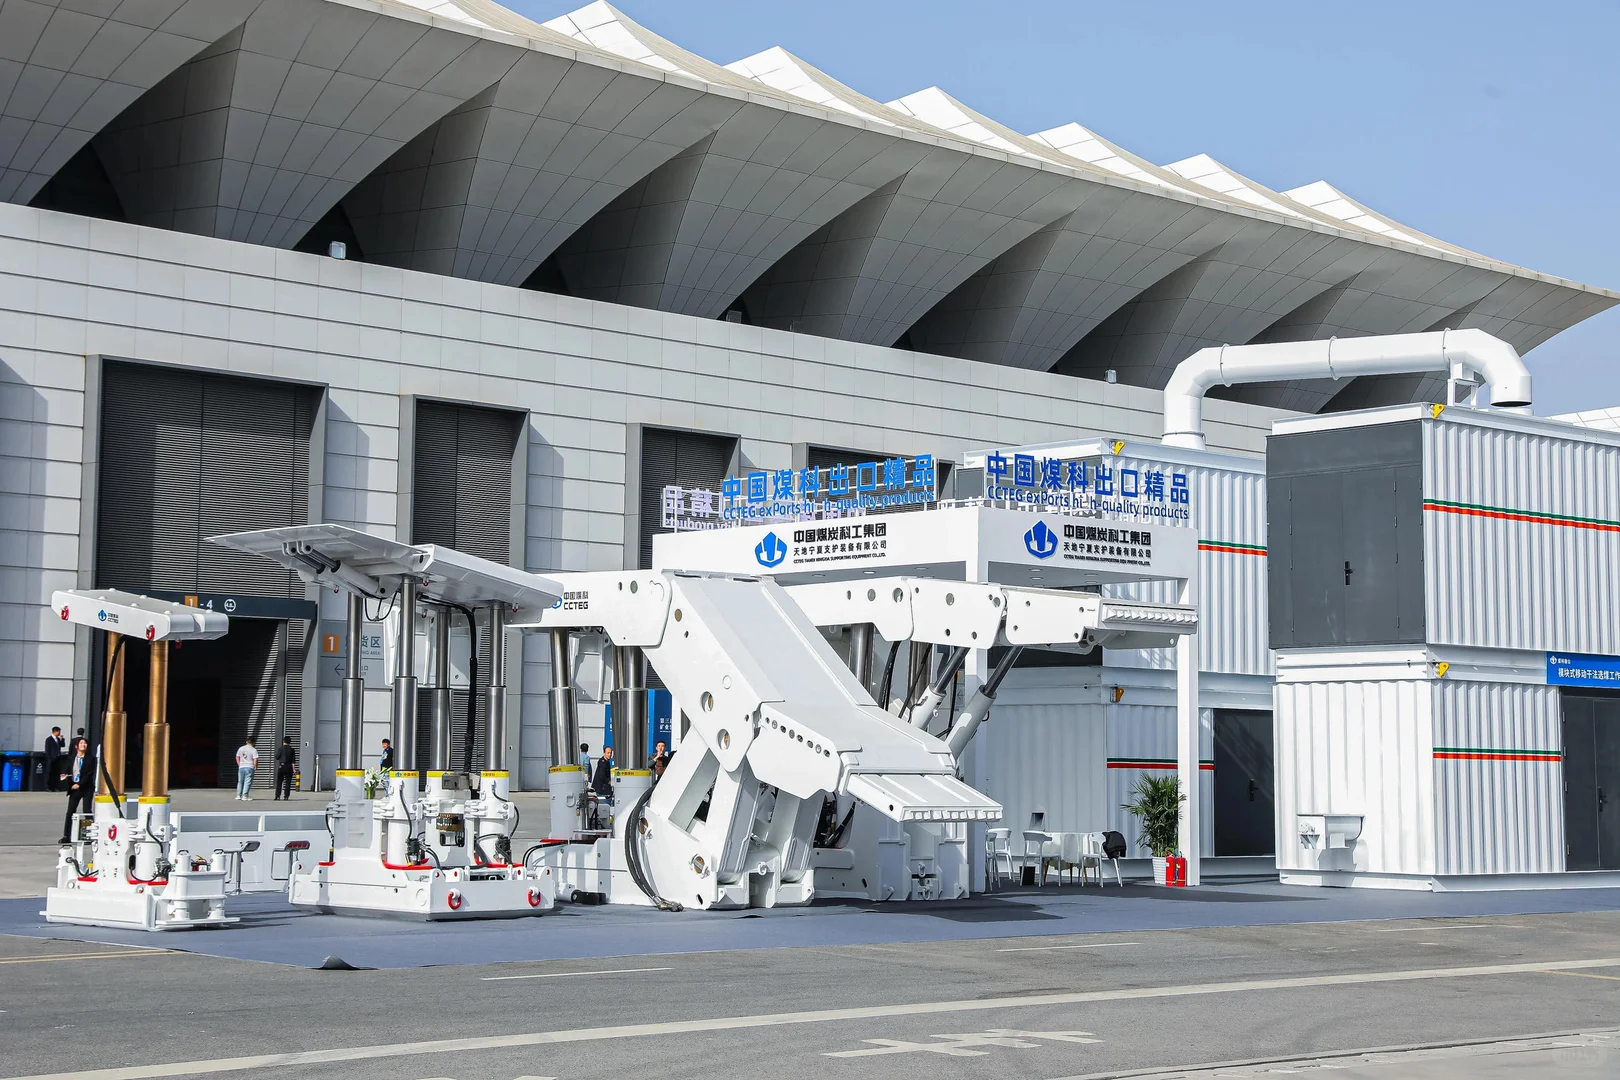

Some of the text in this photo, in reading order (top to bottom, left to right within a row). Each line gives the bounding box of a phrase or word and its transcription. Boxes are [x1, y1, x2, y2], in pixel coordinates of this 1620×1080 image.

[722, 454, 934, 505] 中国煤科出口精品
[987, 451, 1189, 503] 中国煤科出口精品
[724, 505, 756, 520] CCTEG
[882, 489, 934, 509] products
[988, 486, 1023, 501] CCTEG
[1143, 504, 1189, 520] products
[793, 522, 887, 544] 中国煤炭科工集团
[1063, 524, 1151, 546] 中国煤炭科工集团
[793, 540, 887, 557] 天地宁夏支护装备有限公司
[1063, 541, 1151, 558] 天地宁夏支护装备有限公司
[563, 601, 588, 610] CCTEG
[328, 636, 334, 651] 1
